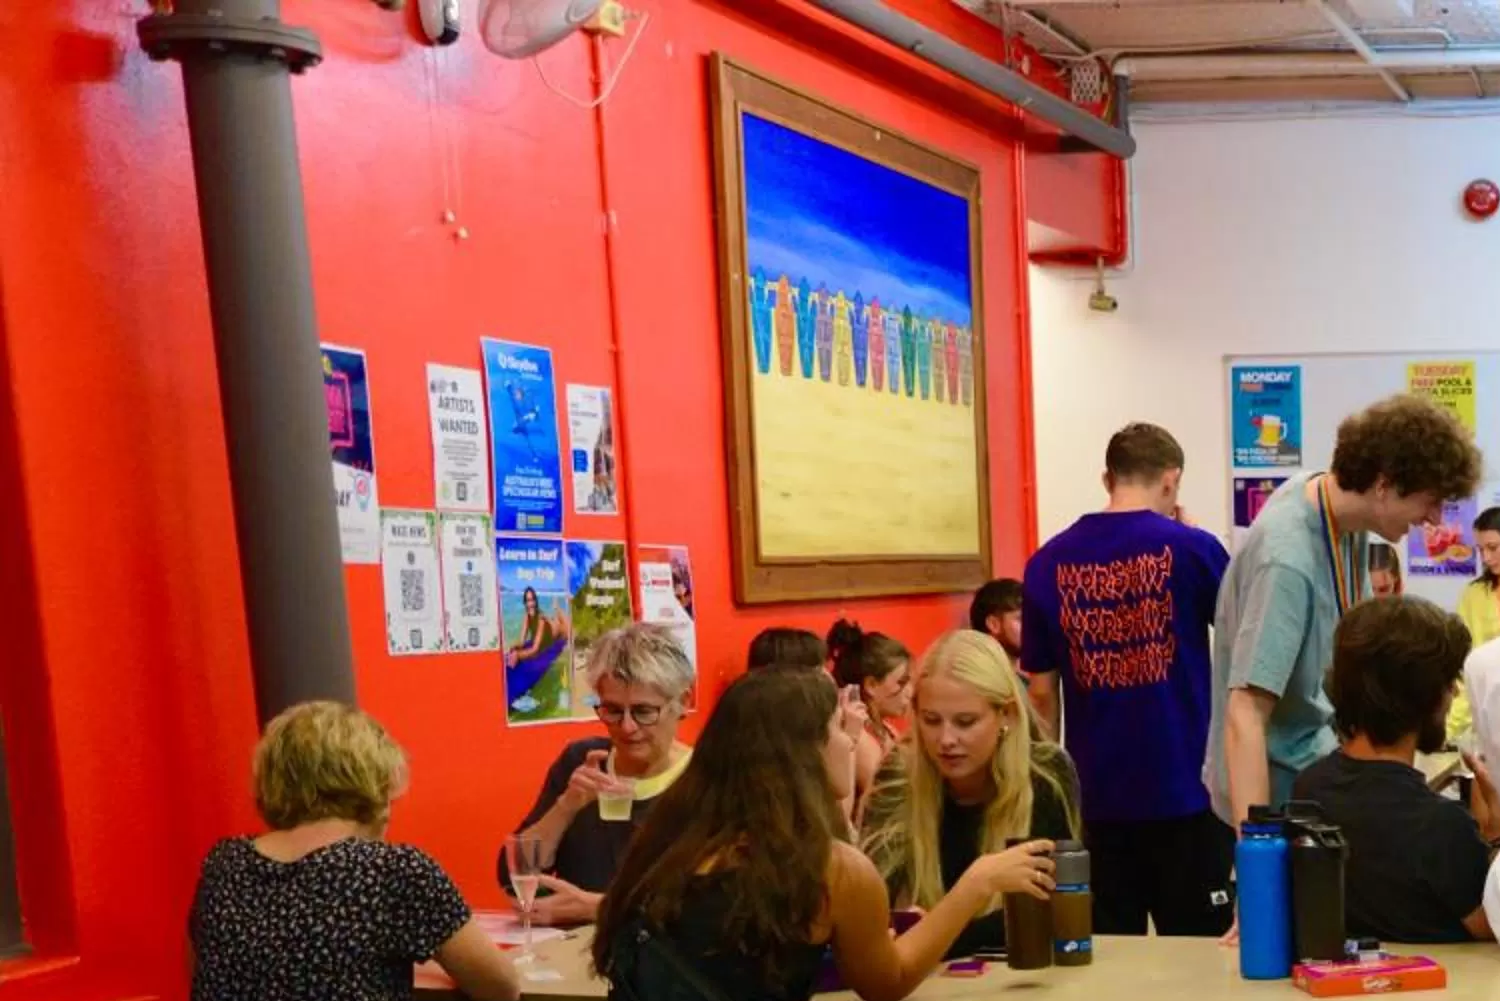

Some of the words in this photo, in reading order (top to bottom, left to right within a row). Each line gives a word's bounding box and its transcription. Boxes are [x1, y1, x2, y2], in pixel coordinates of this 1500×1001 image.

[1240, 371, 1293, 383] MONDAY
[1437, 378, 1462, 387] POOL
[438, 395, 475, 415] ARTISTS
[438, 417, 479, 436] WANTED
[498, 547, 526, 562] Learn
[537, 548, 558, 562] Surf
[535, 567, 556, 582] Trip
